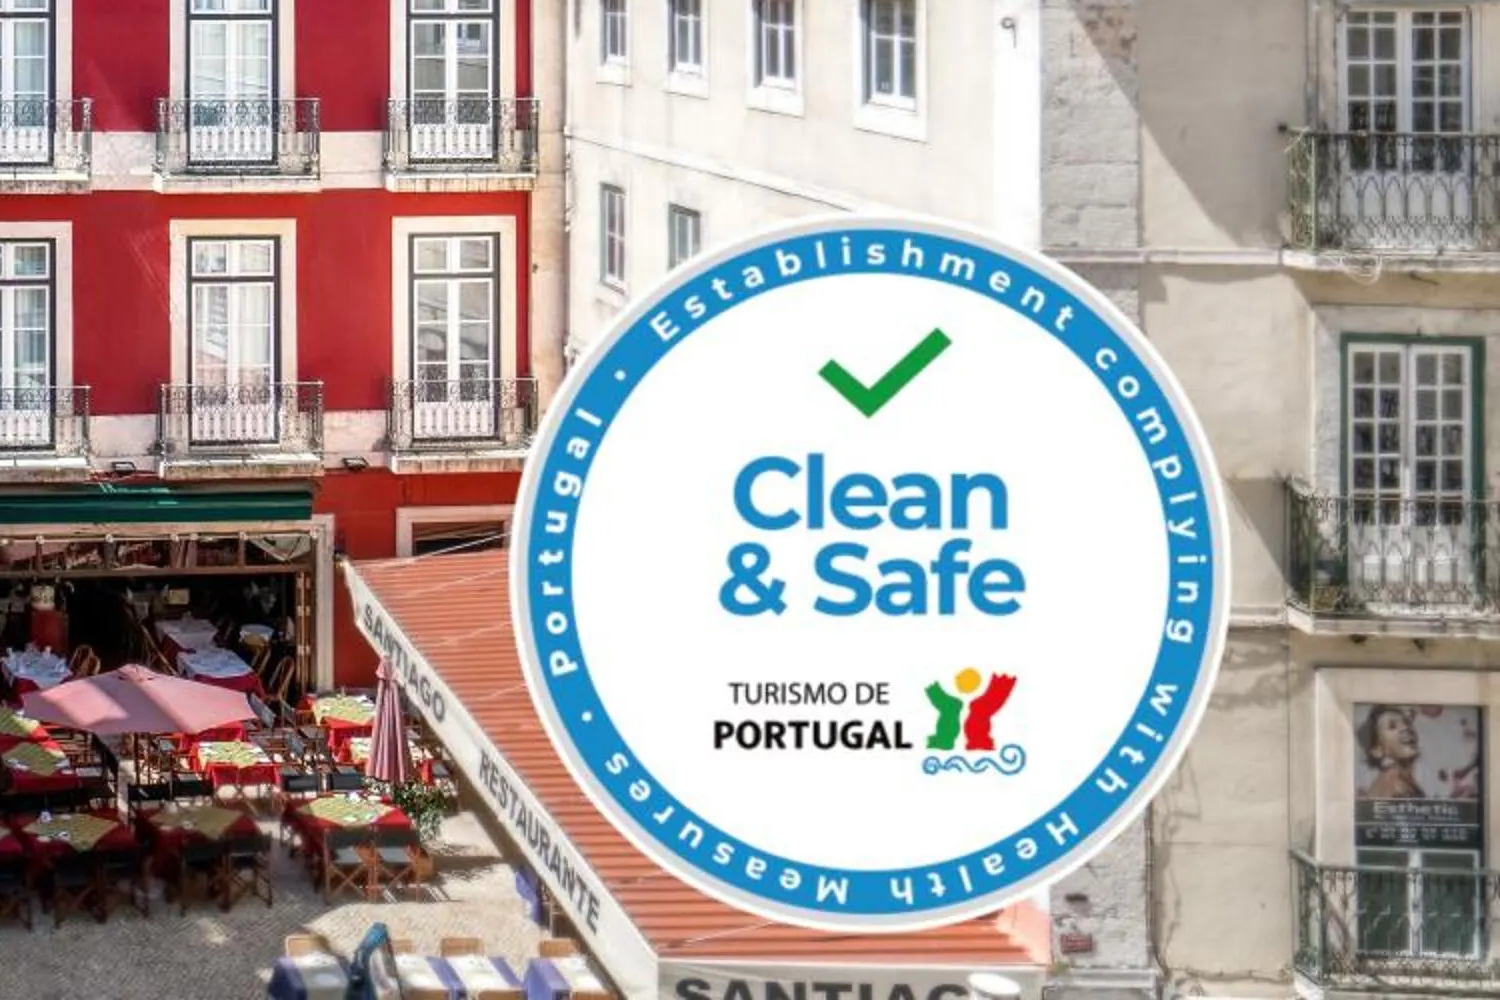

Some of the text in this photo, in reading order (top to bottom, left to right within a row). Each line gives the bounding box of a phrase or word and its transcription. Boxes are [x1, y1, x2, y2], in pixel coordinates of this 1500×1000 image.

[364, 603, 446, 724] SANTIAGO
[479, 750, 601, 935] RESTAURANTE
[675, 978, 970, 1000] SANTIA
